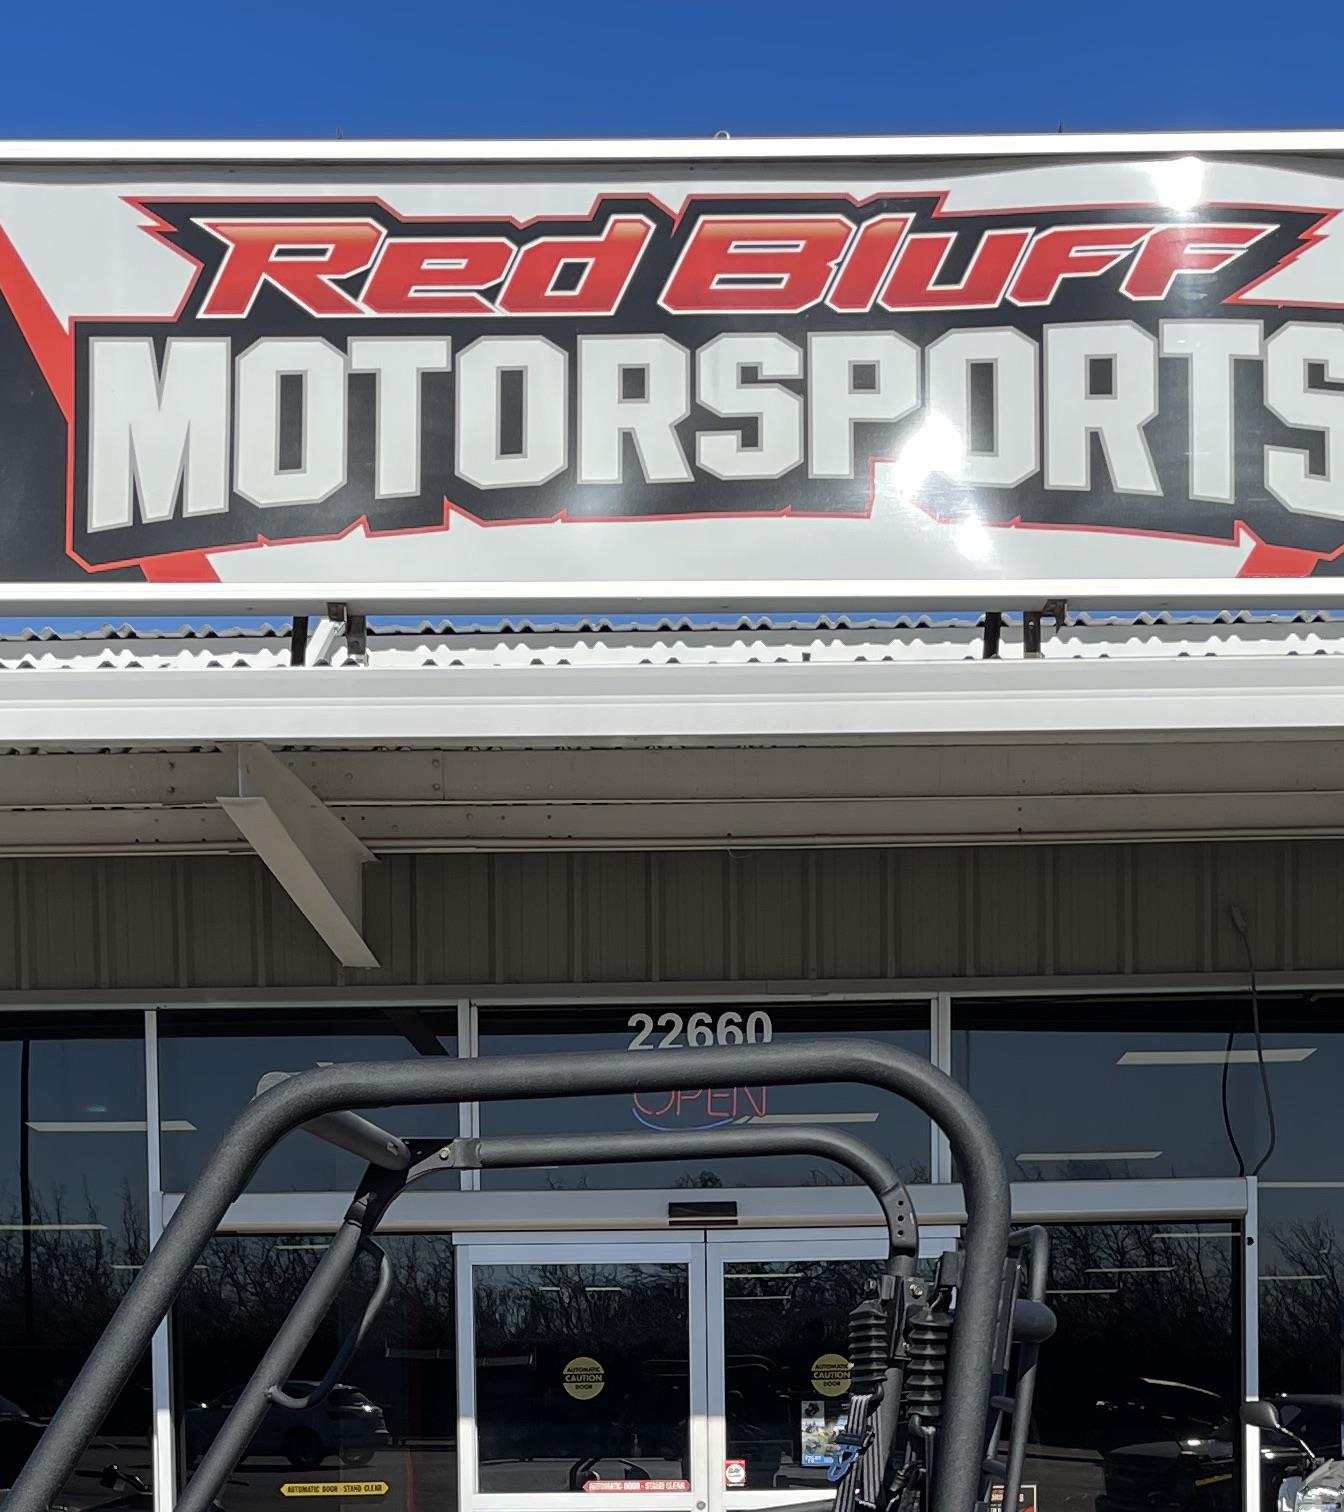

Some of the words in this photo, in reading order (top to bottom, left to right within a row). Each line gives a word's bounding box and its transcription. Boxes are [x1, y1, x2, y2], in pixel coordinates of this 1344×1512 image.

[189, 213, 657, 318] Red
[627, 1010, 773, 1051] 22660
[565, 1374, 603, 1382] CAUTION
[813, 1371, 851, 1379] CAUTION
[287, 1485, 320, 1493] AUTOMATIC
